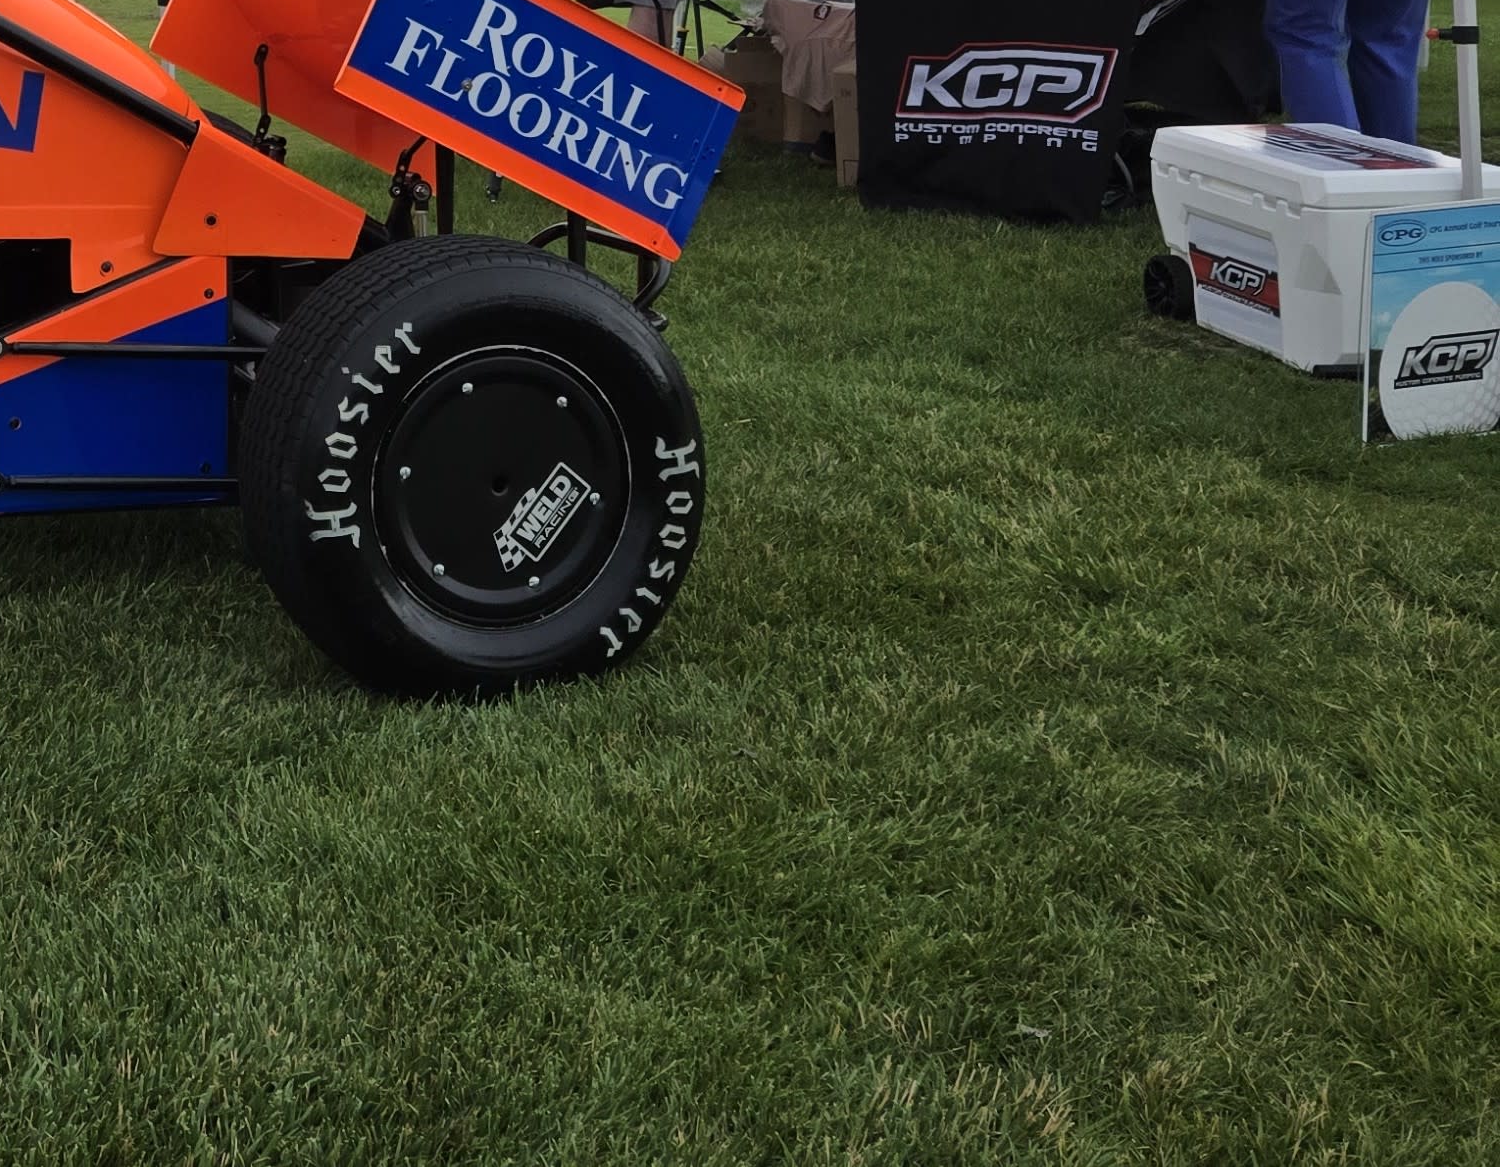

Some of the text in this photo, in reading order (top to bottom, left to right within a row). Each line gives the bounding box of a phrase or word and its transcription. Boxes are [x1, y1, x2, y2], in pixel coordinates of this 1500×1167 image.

[905, 49, 1105, 111] KCP
[385, 17, 689, 210] FLOORING
[894, 122, 1099, 141] KUSTOM CONCRETE
[1381, 228, 1423, 241] CPG
[1210, 260, 1266, 296] KCP
[1400, 332, 1497, 378] KCP
[304, 322, 421, 549] Hoosier
[516, 474, 572, 542] WELD
[534, 490, 580, 549] RACING
[599, 436, 700, 658] Hoosier
